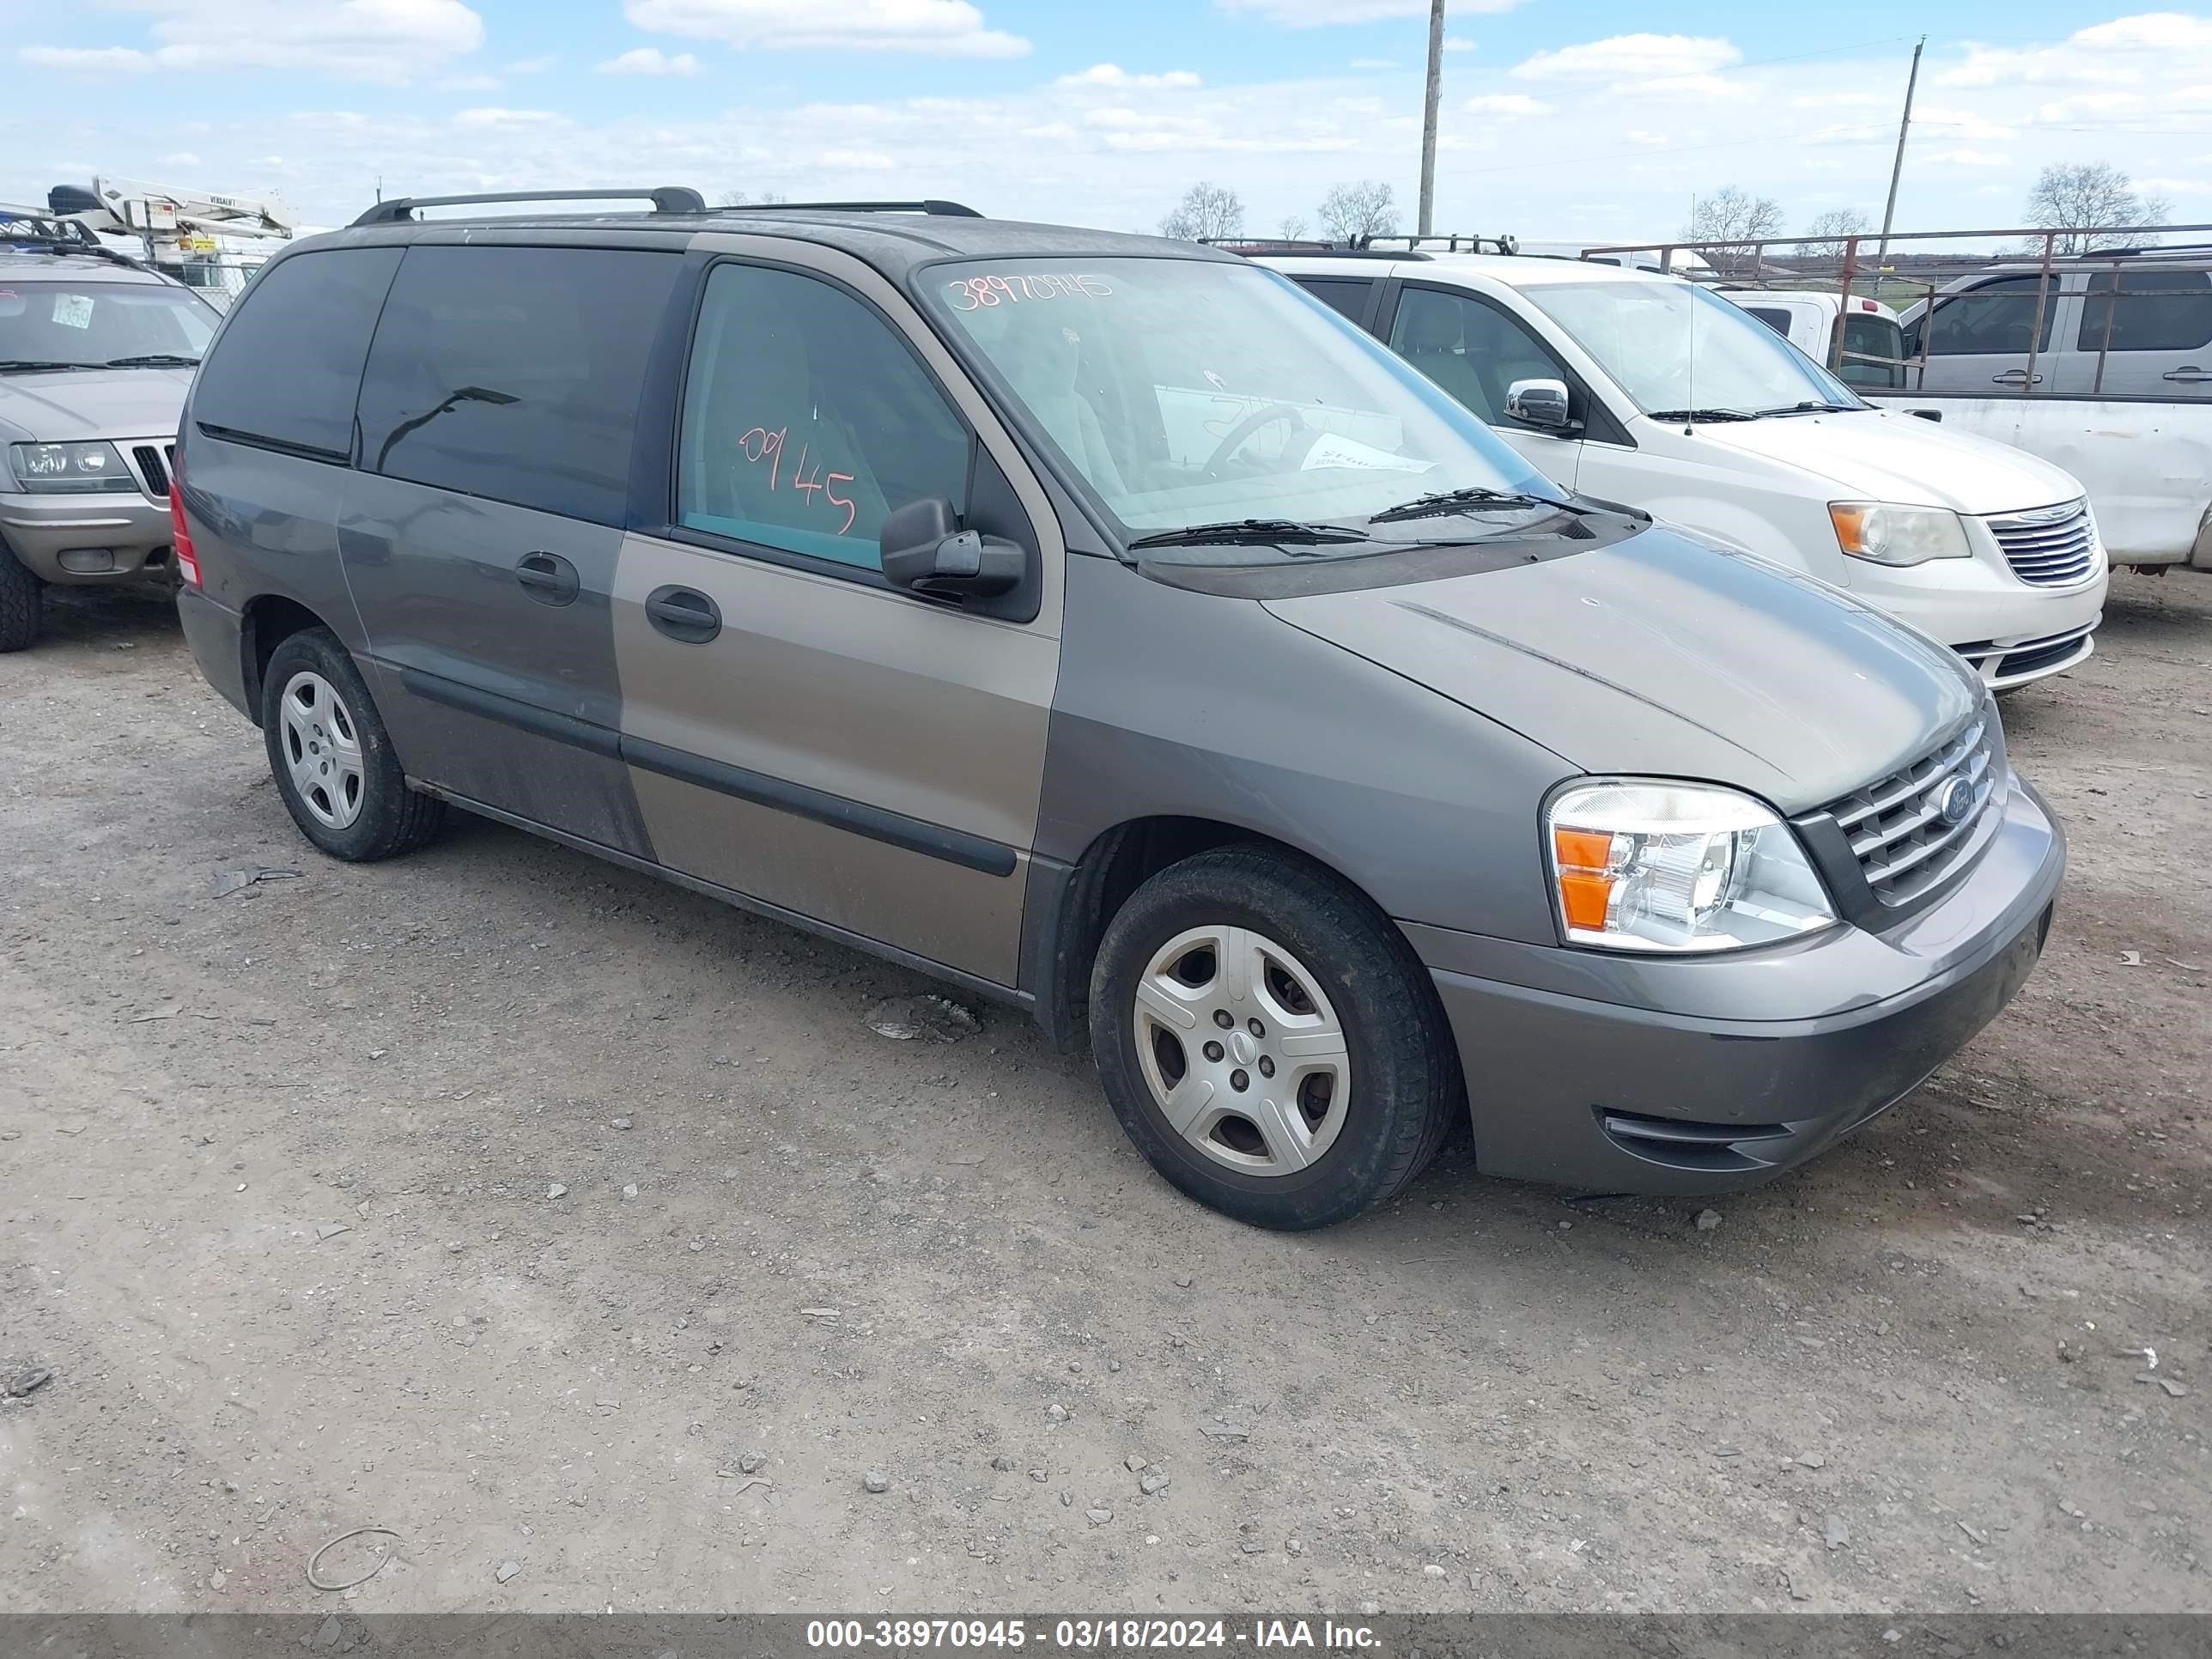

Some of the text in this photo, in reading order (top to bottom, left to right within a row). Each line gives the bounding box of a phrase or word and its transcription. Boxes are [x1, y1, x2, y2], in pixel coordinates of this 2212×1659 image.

[949, 273, 1113, 311] 38970945
[55, 303, 91, 326] 1359
[1953, 785, 1971, 815] Ford
